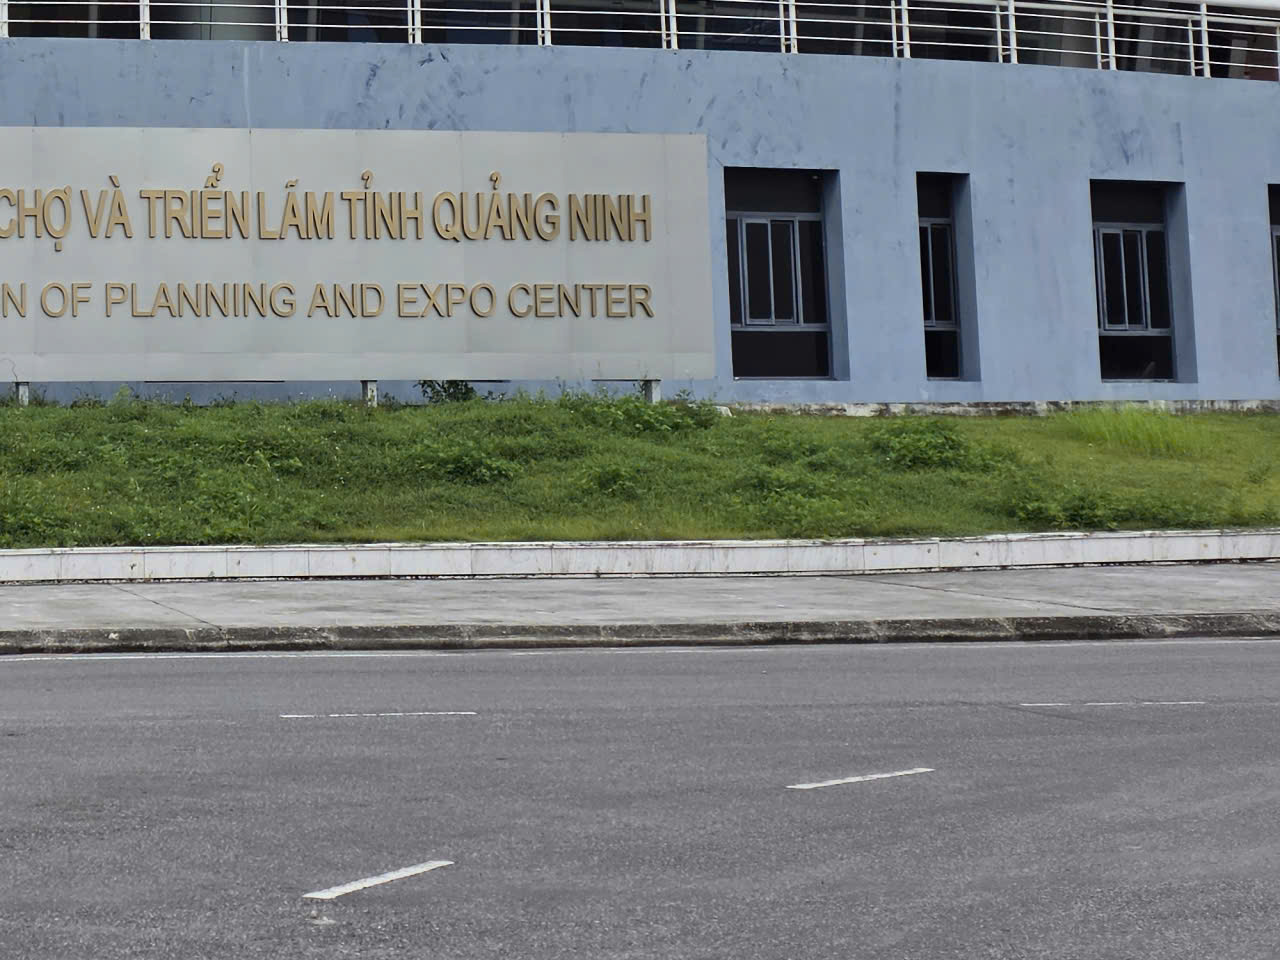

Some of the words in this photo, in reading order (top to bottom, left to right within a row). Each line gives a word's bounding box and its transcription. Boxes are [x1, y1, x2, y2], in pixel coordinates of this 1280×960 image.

[80, 175, 134, 239] VÀ
[139, 162, 249, 240] TRIỂN
[257, 179, 335, 240] LÃM
[341, 169, 423, 241] TỈNH
[432, 170, 560, 242] QUẢNG
[568, 193, 652, 242] NINH
[40, 281, 92, 317] OF
[105, 282, 297, 318] PLANNING
[307, 283, 385, 318] AND
[397, 283, 497, 318] EXPO
[507, 283, 655, 318] CENTER
